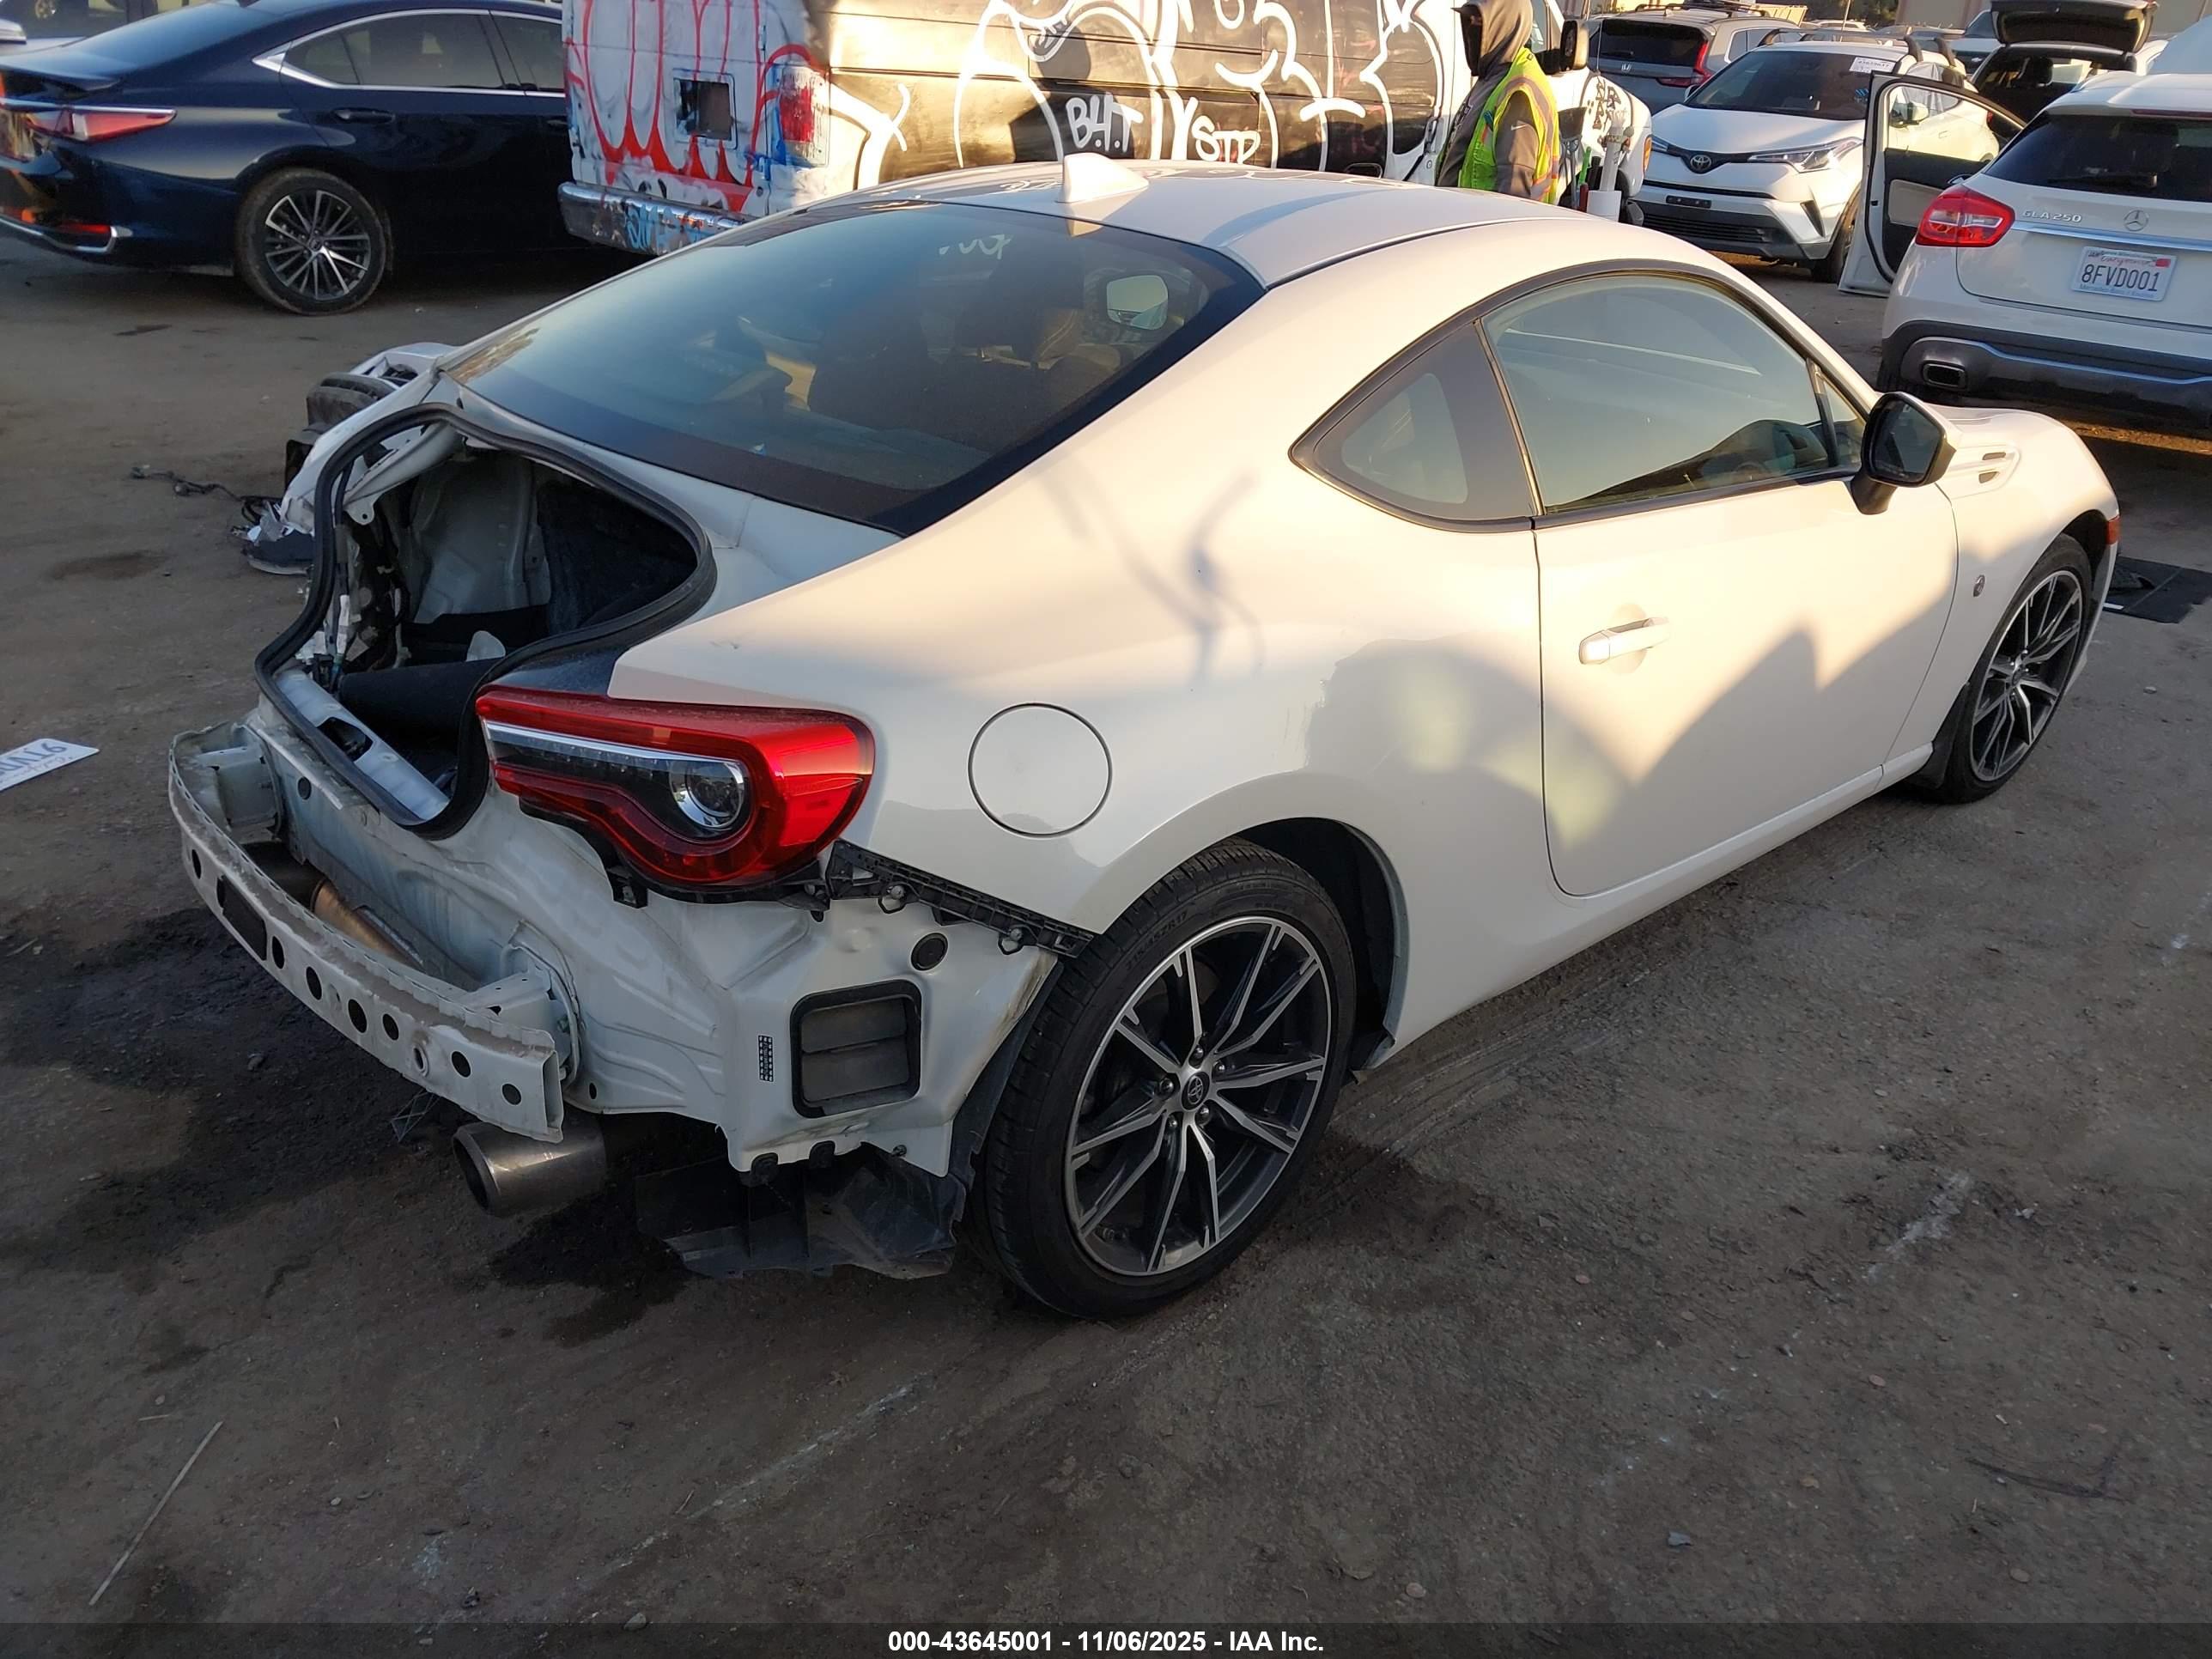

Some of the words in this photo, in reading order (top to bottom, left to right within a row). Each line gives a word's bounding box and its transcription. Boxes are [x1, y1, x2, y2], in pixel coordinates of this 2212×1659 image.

[2022, 210, 2050, 220] GLA
[2052, 213, 2082, 223] 250
[2081, 264, 2160, 292] 8FVD001
